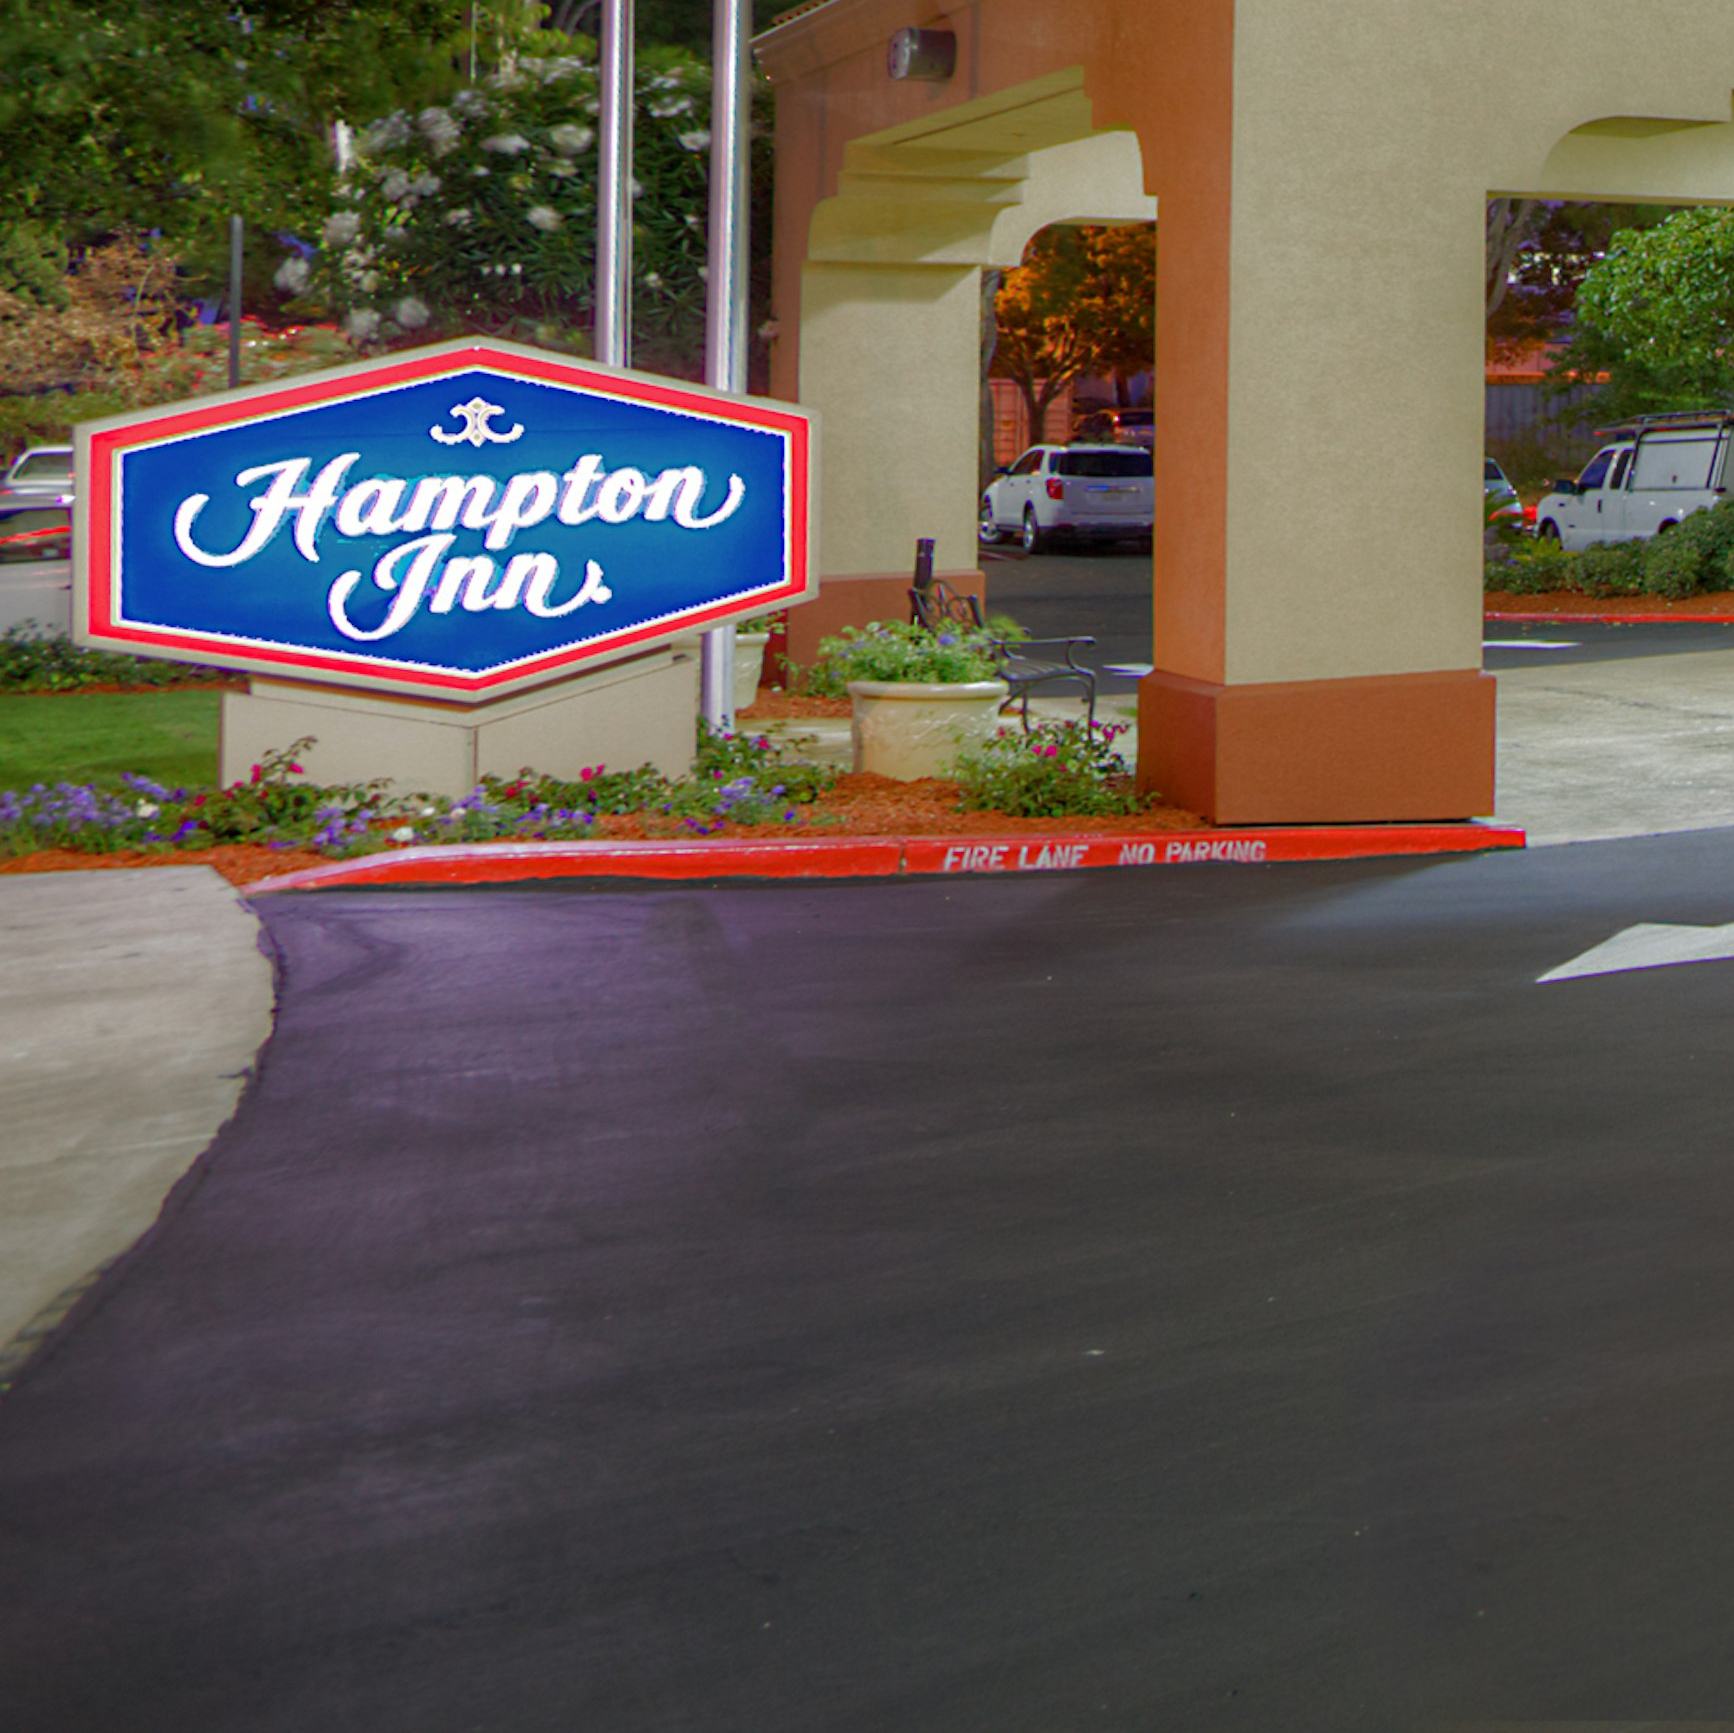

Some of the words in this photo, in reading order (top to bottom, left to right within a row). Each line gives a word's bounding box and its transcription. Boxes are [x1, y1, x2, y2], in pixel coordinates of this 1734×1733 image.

[175, 452, 745, 567] Hampton
[329, 534, 606, 642] Inn
[943, 846, 1009, 871] FIRE
[1018, 844, 1090, 869] LANE
[1118, 843, 1156, 866] NO
[1165, 840, 1267, 864] PARKING
